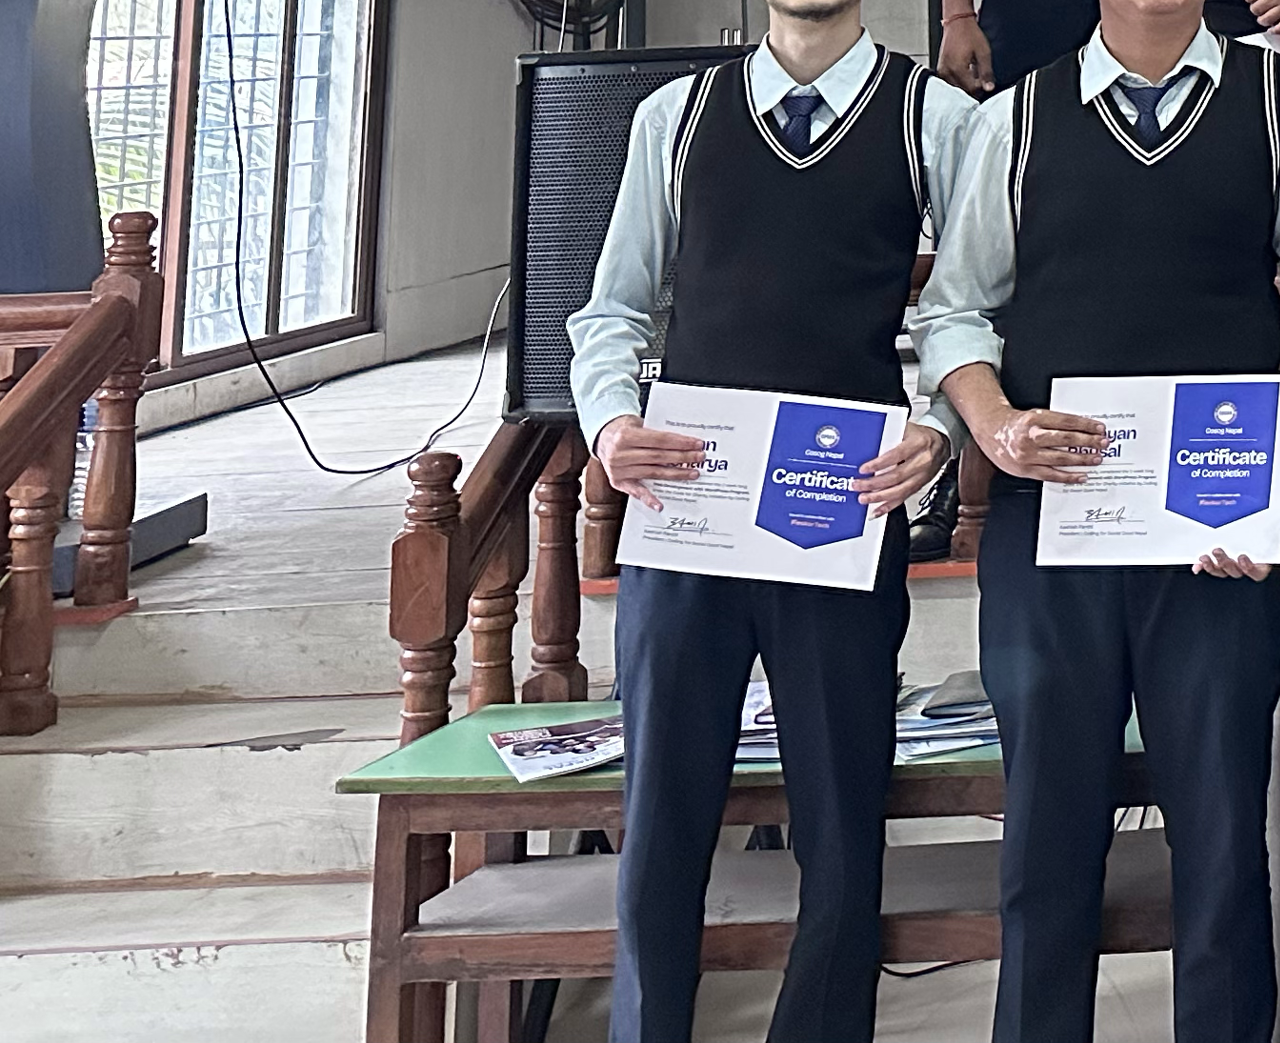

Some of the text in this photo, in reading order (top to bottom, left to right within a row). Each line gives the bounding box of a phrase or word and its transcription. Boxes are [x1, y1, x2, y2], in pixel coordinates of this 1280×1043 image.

[1176, 448, 1268, 466] Certificate
[772, 468, 856, 491] Certificat
[1190, 468, 1250, 479] of Completion
[785, 489, 847, 503] of Completion
